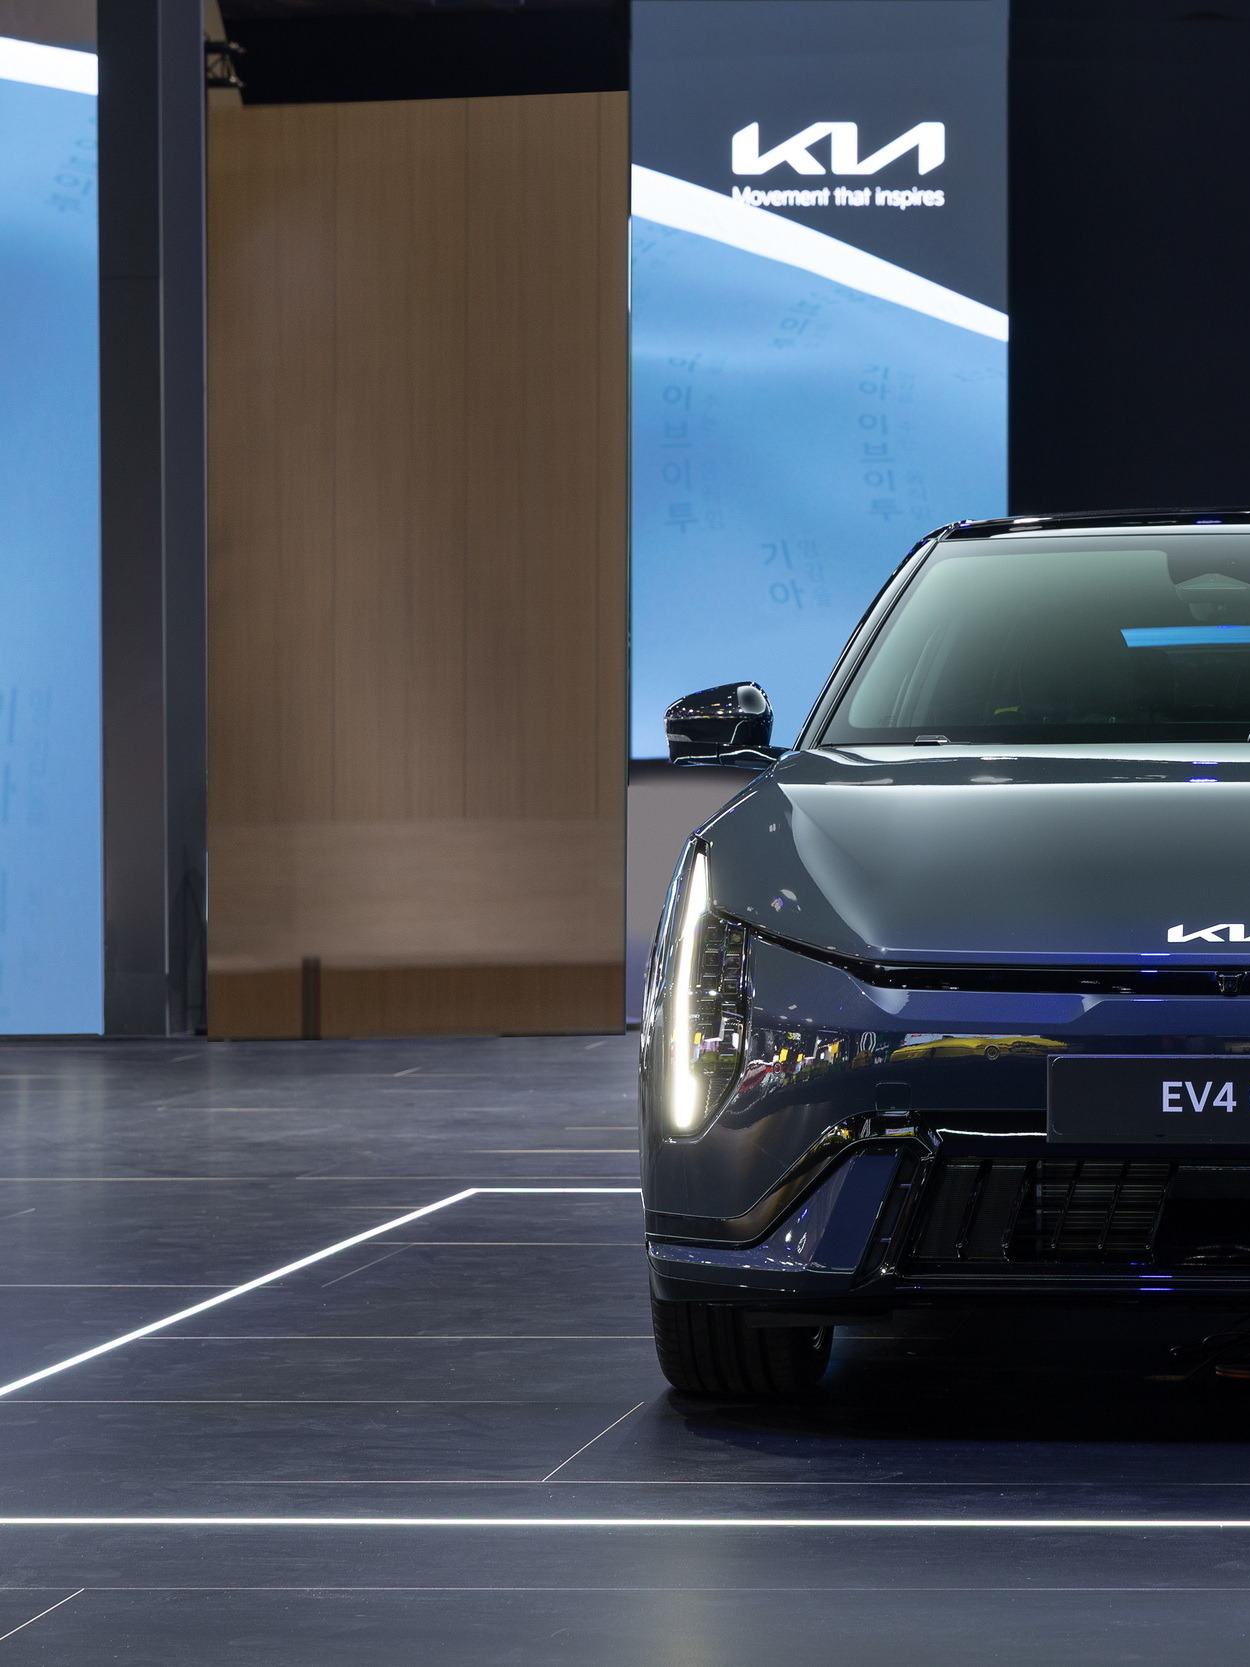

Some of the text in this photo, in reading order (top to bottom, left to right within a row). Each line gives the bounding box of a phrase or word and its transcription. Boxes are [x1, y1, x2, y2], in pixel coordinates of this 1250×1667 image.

[732, 121, 946, 175] KIA
[732, 186, 945, 210] Movement that inspires
[759, 538, 805, 611] 기아
[1162, 1081, 1237, 1113] EV4
